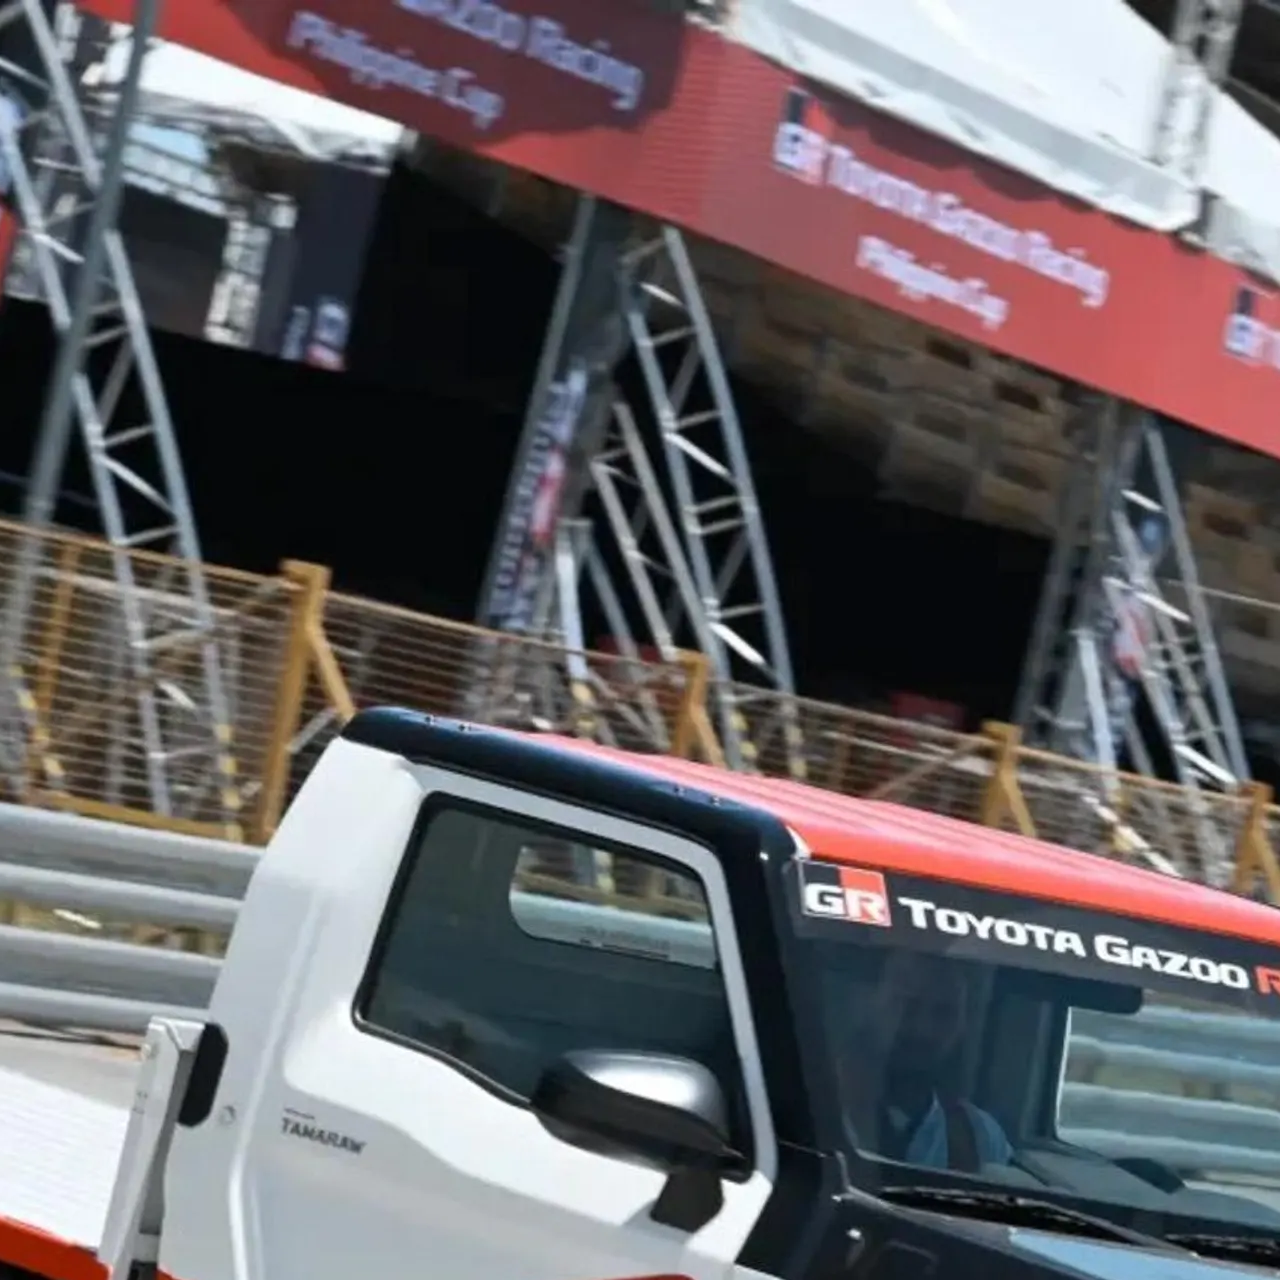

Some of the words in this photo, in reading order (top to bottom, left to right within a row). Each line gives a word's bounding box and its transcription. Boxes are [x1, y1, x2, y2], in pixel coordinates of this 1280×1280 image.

[803, 880, 888, 927] GR
[897, 895, 1087, 959] TOYOTA
[1094, 934, 1251, 990] GAZOO
[282, 1117, 367, 1155] TAMARAW
